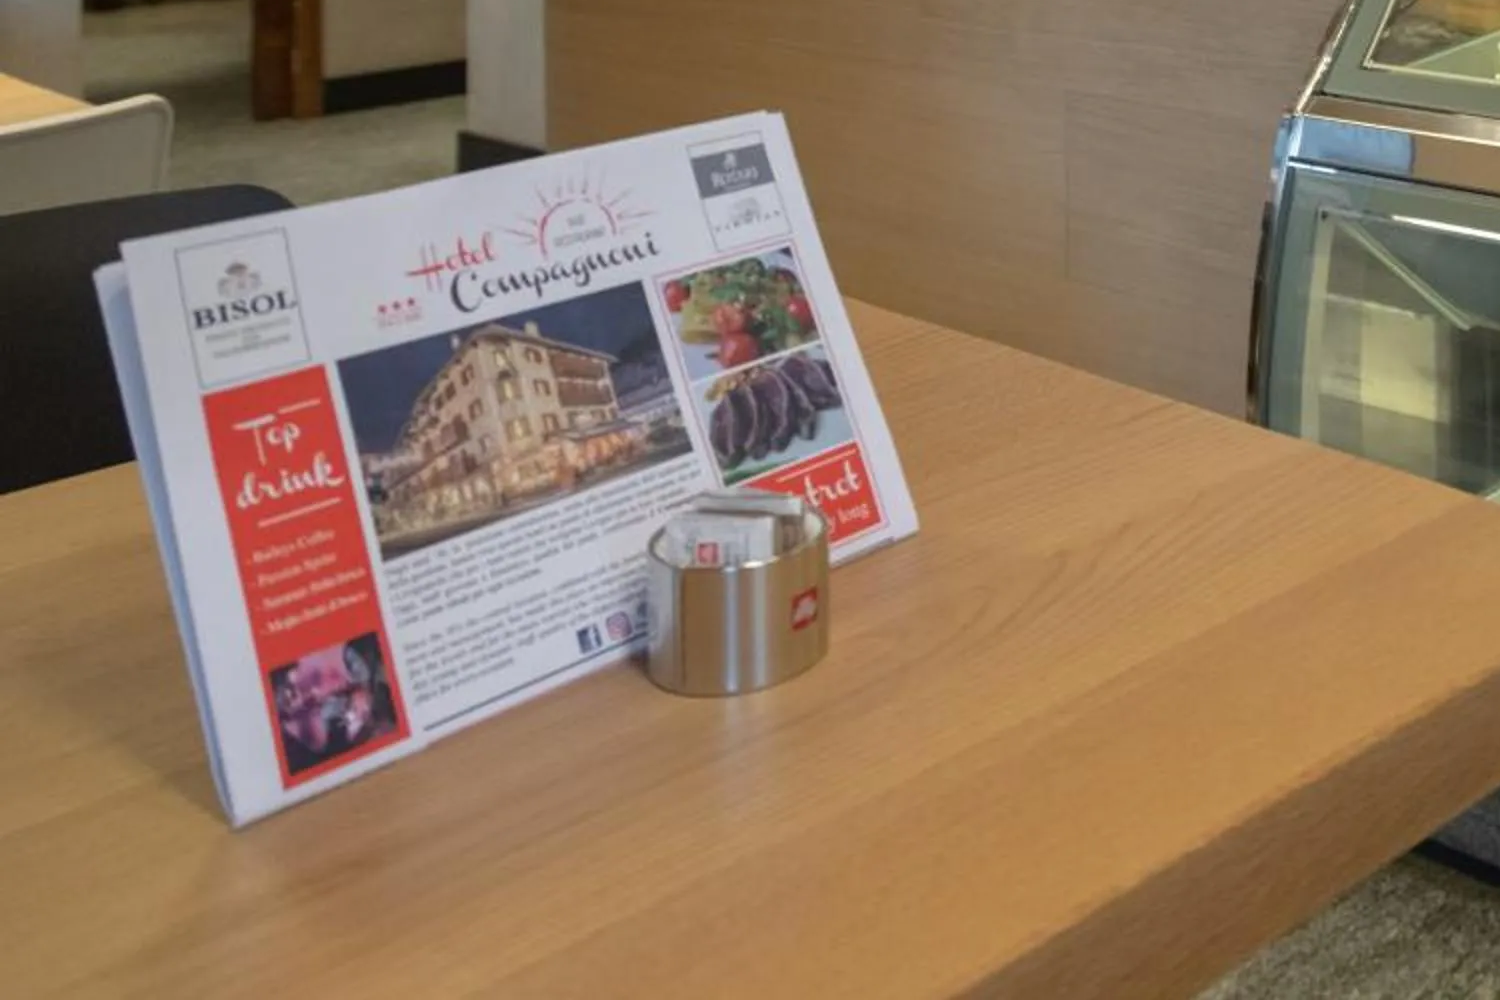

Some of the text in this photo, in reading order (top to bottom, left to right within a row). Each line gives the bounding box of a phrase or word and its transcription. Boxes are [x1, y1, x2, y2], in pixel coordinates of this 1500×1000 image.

[407, 231, 496, 293] Hotel
[450, 232, 660, 312] Compagnoni
[193, 290, 299, 330] BISOL
[232, 413, 301, 467] Top
[236, 451, 345, 509] drink
[803, 459, 863, 507] trot
